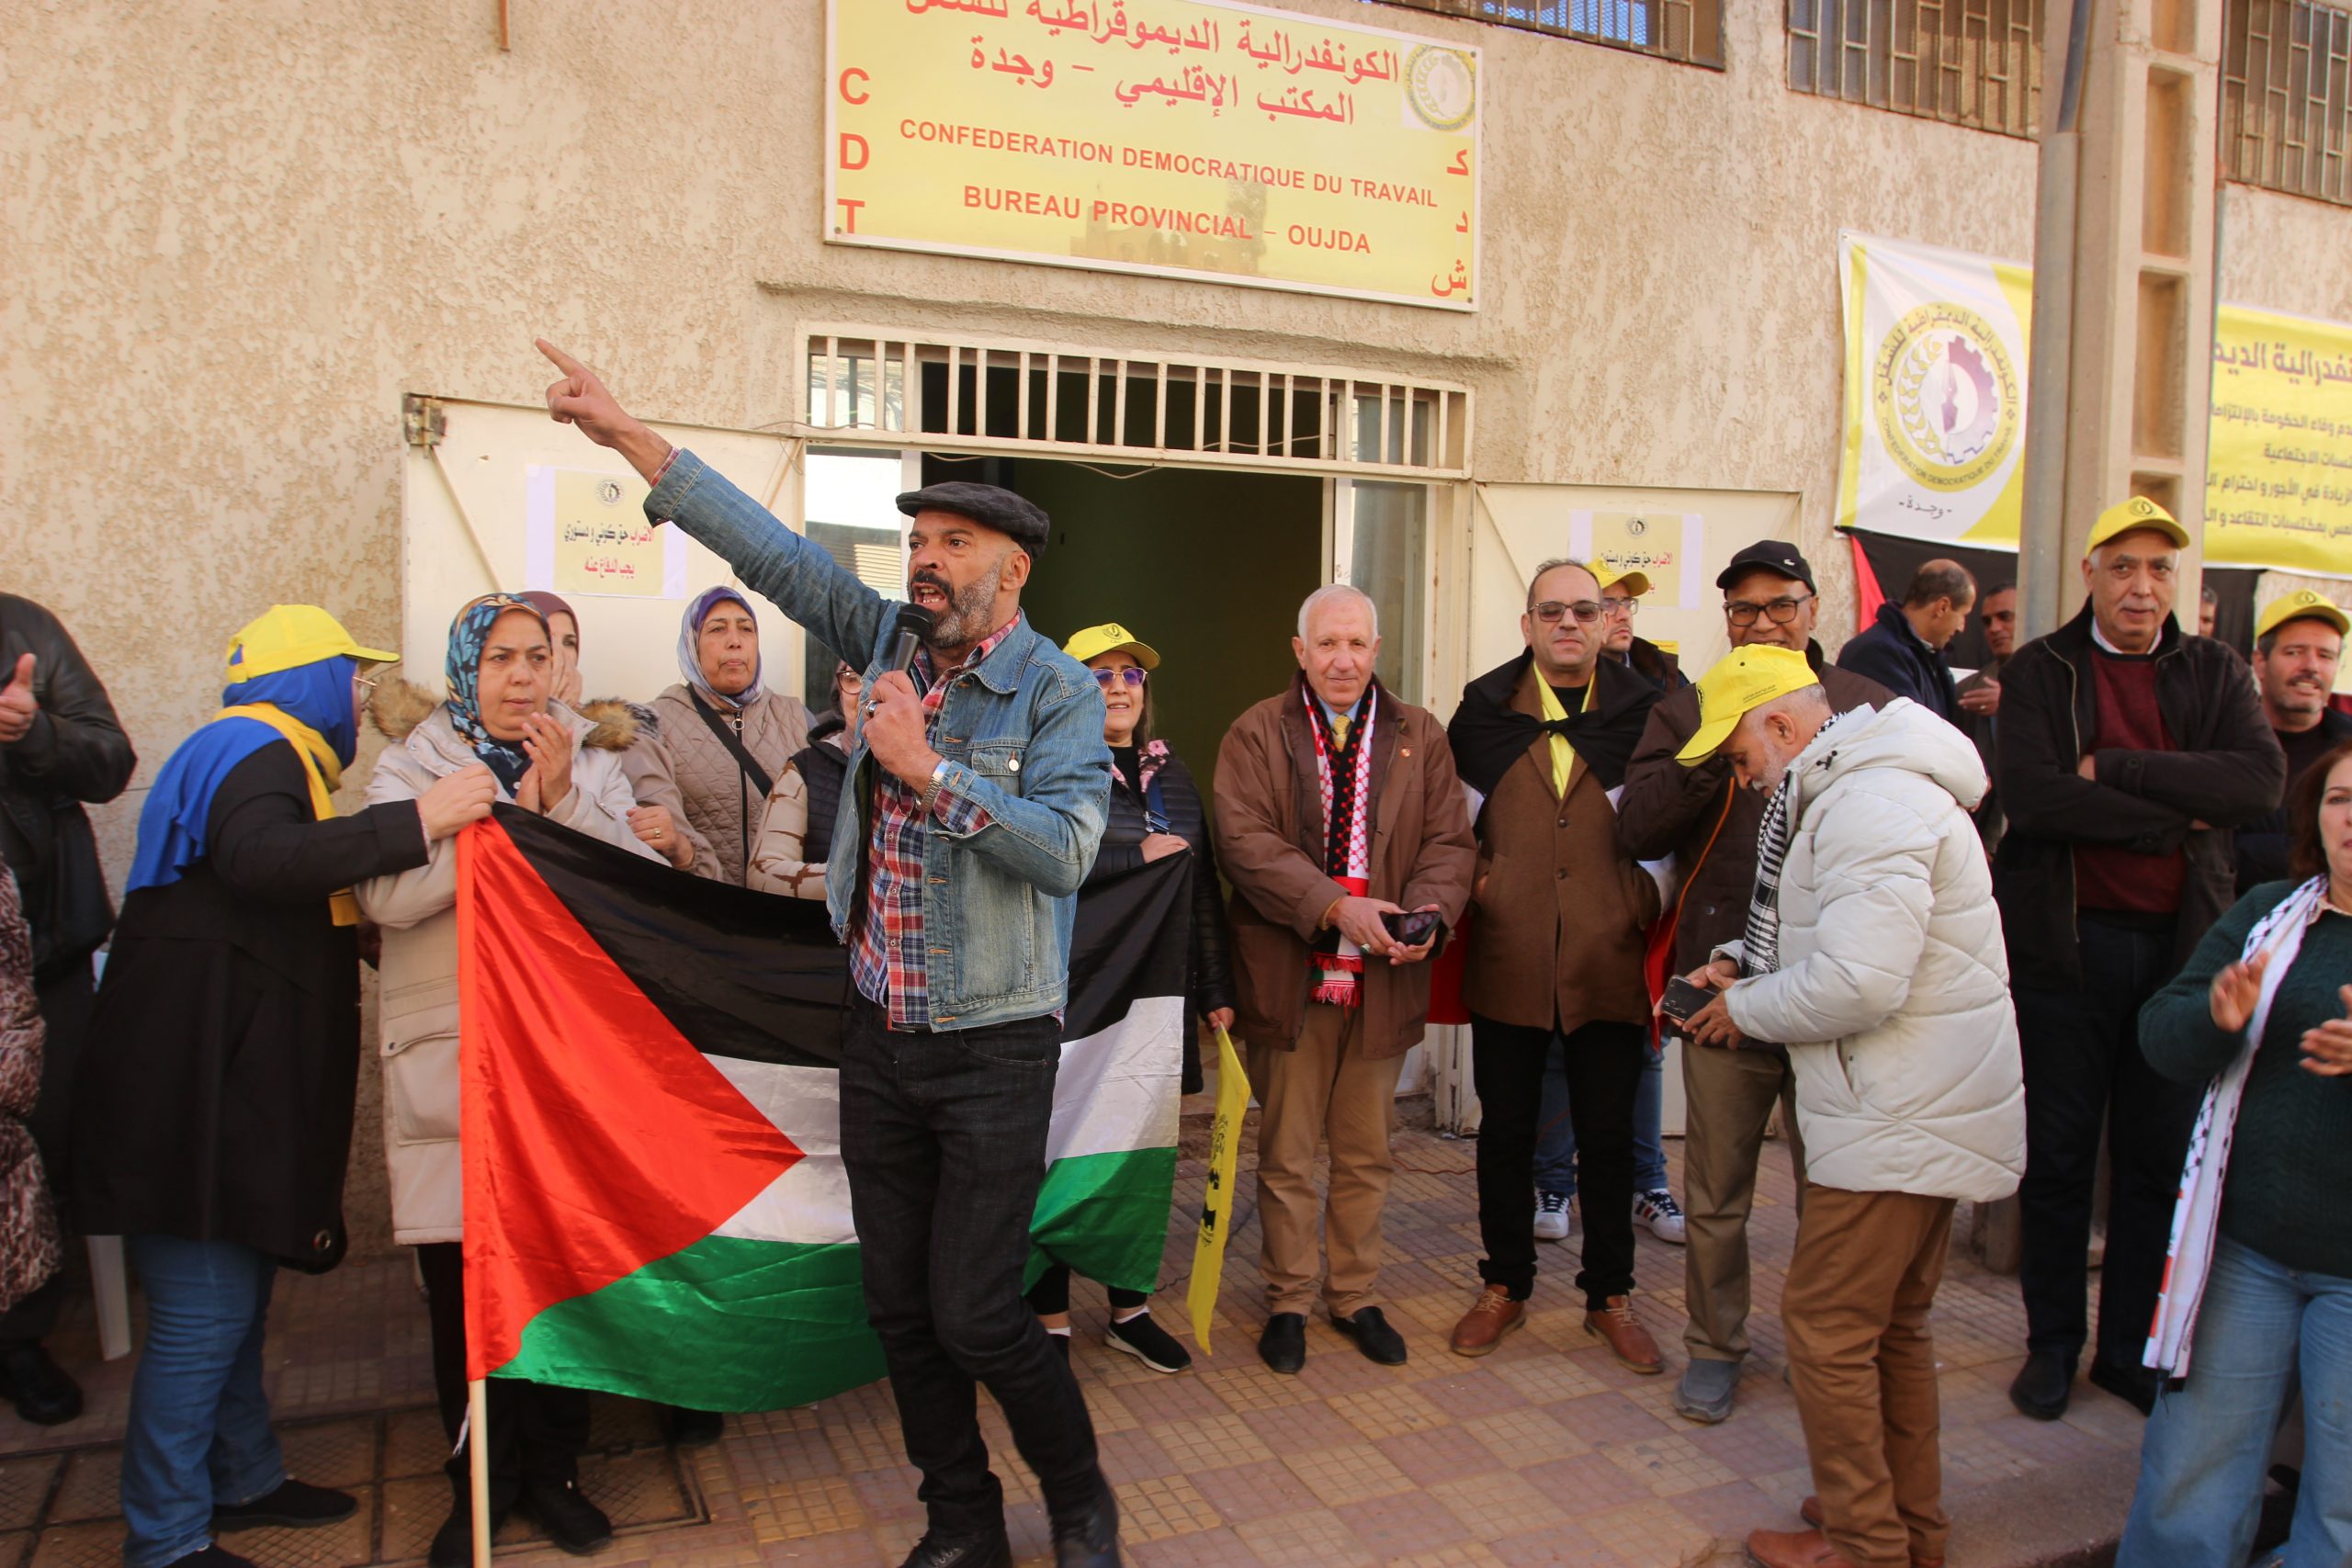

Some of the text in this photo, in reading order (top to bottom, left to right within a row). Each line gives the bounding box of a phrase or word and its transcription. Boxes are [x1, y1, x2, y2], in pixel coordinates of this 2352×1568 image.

[970, 35, 1054, 89] وجدة
[1237, 18, 1398, 85] الكونفدرالية
[1115, 64, 1238, 118] الإقليمي
[1257, 86, 1353, 125] المكتب
[899, 118, 1438, 208] CONFEDERATION DEMOCRATIQUE DU TRAVAIL
[965, 185, 1080, 219] BUREAU
[1093, 200, 1253, 240] PROVINCIAL
[1288, 224, 1372, 254] OUJDA
[2262, 408, 2308, 430] الحكومة
